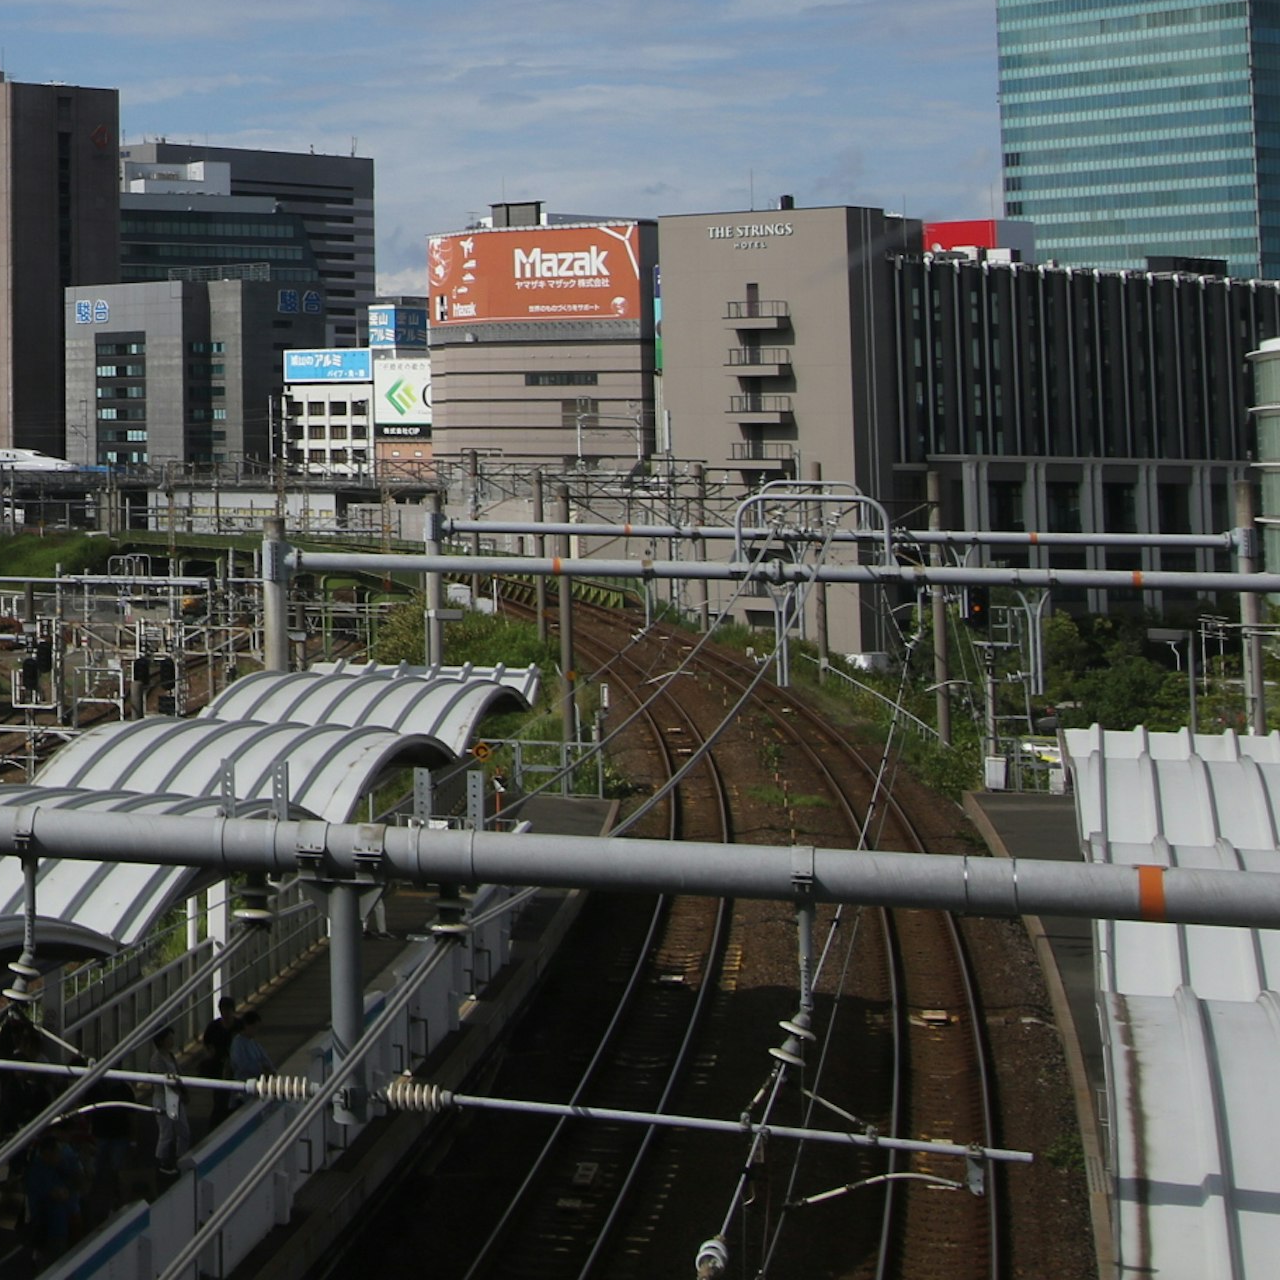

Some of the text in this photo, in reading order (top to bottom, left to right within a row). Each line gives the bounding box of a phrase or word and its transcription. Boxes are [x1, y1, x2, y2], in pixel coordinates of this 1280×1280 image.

[707, 222, 793, 239] THE STRINGS
[733, 241, 768, 249] HOTEL
[514, 245, 610, 279] Mazak
[515, 278, 610, 290] ヤマザキ マザック 株式会社
[277, 289, 322, 314] 駿台
[75, 299, 109, 324] 駿台
[369, 328, 395, 342] アルミ
[396, 328, 427, 342] アルミ
